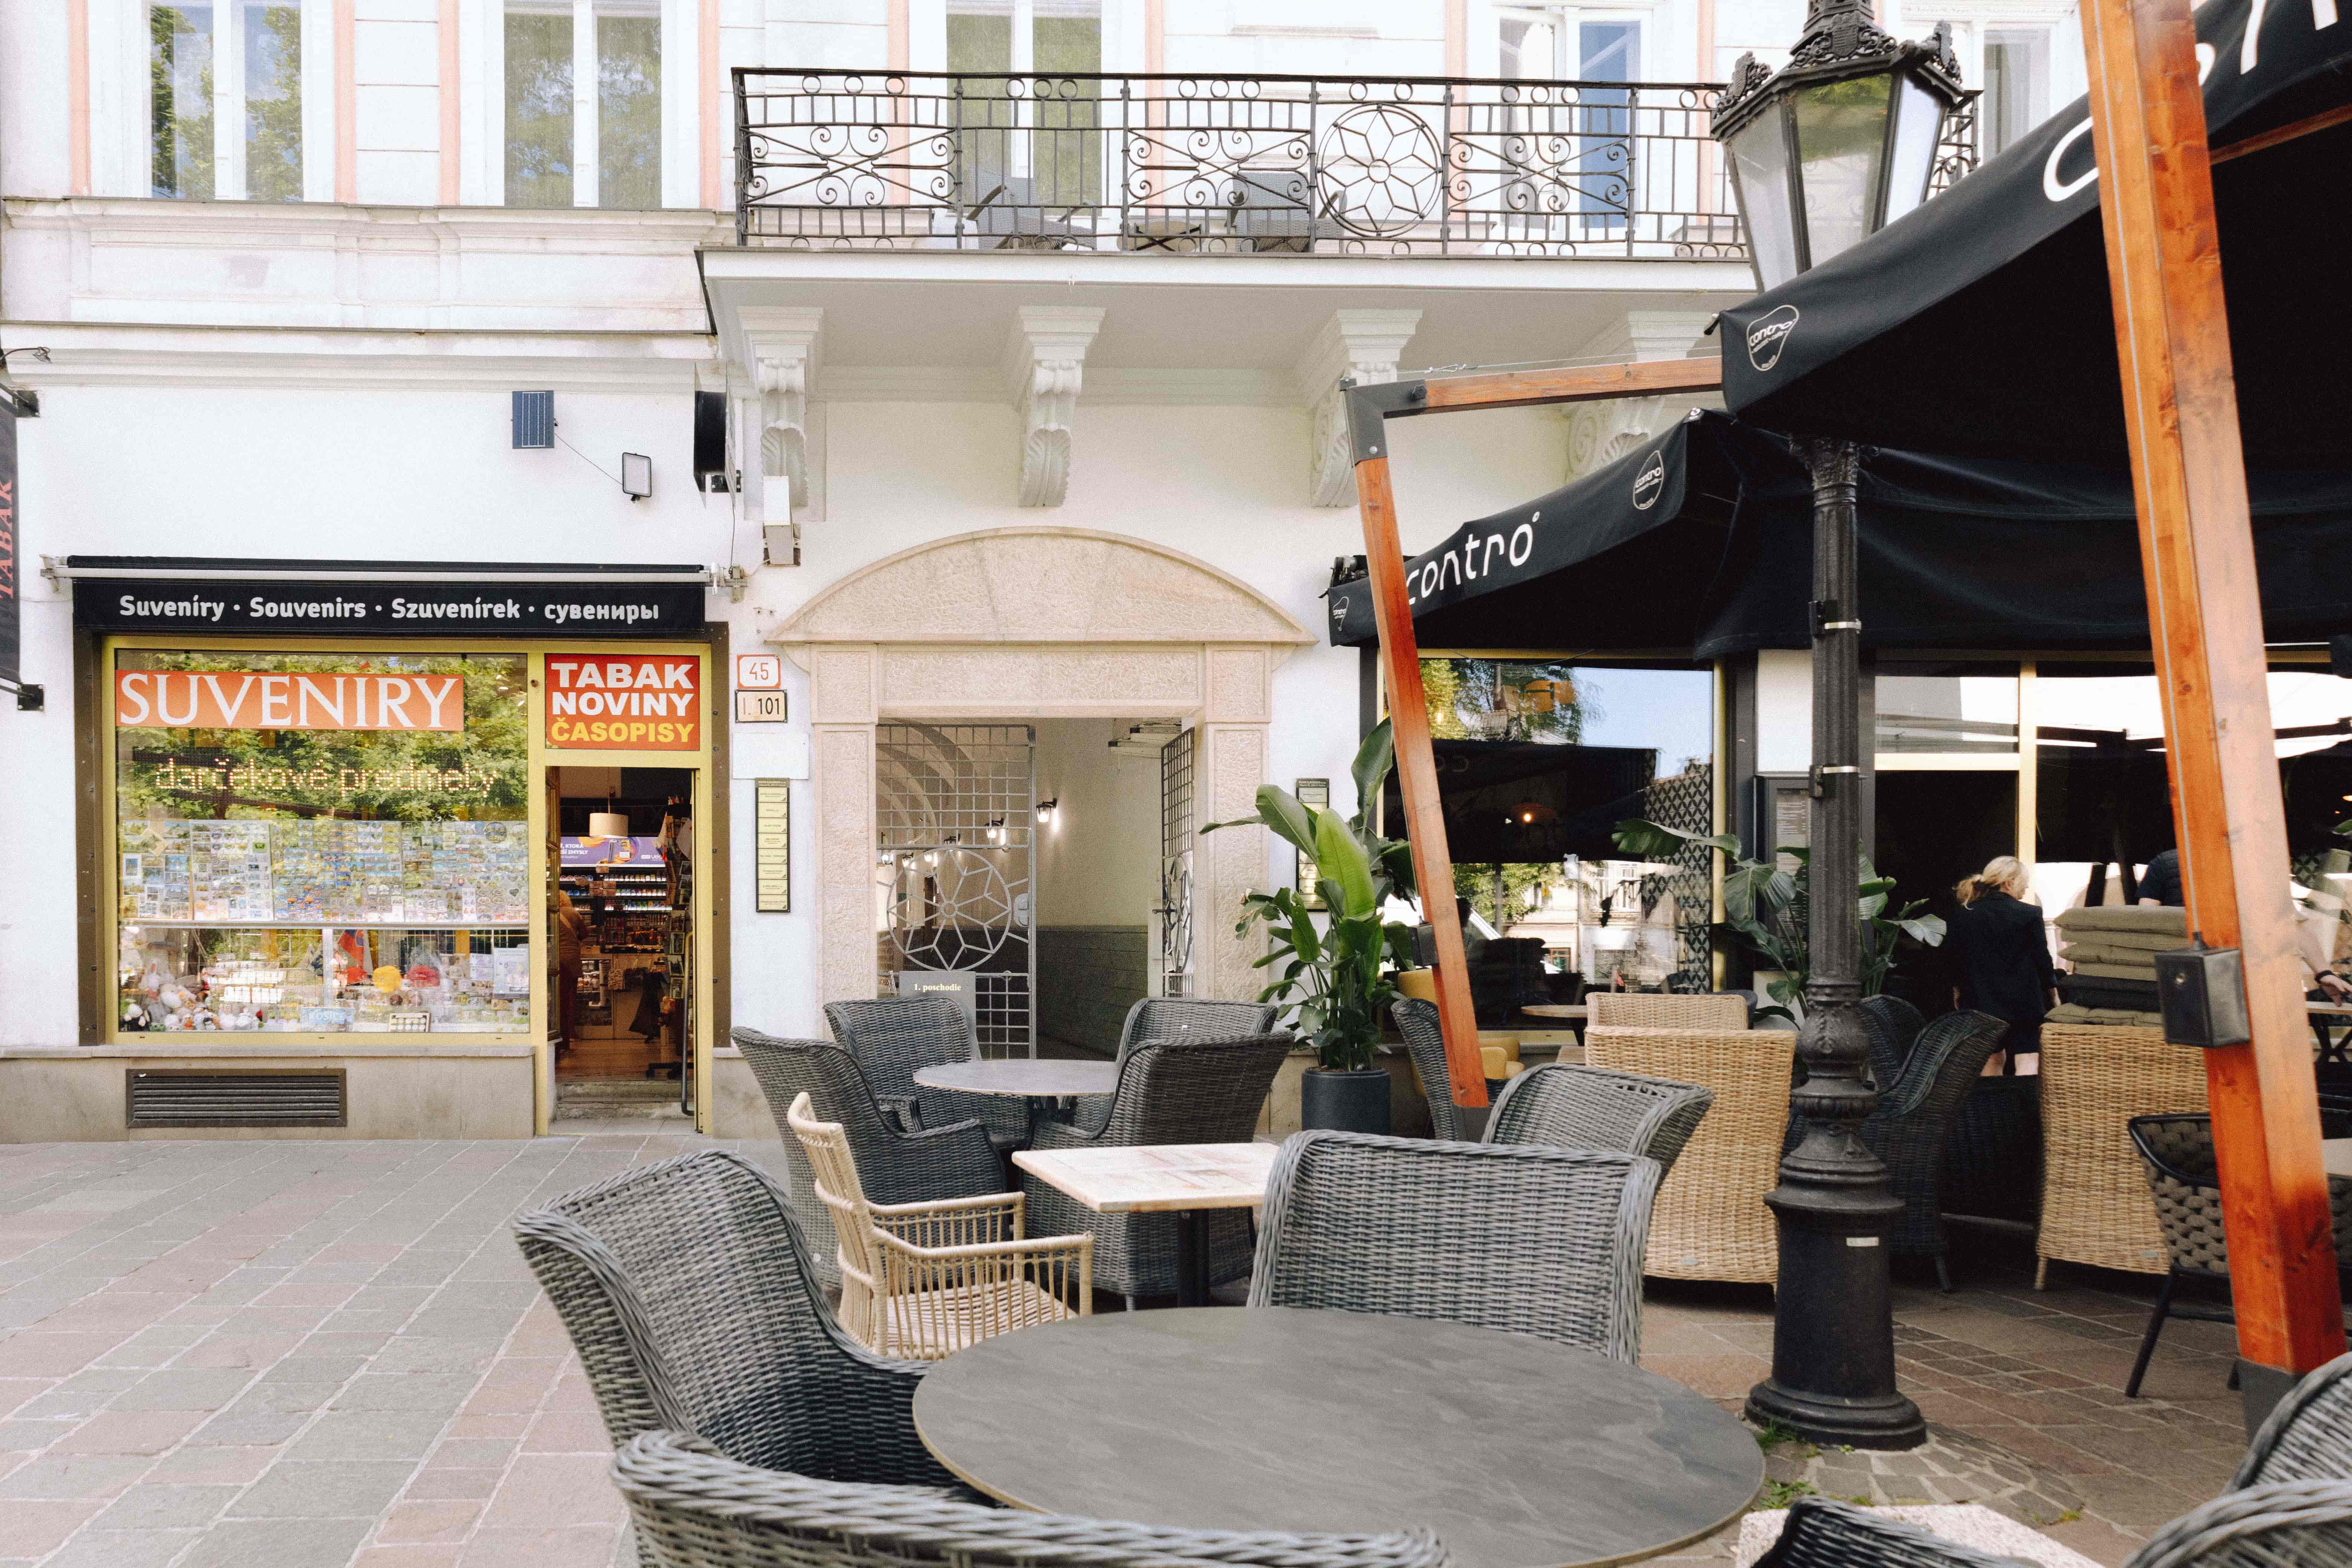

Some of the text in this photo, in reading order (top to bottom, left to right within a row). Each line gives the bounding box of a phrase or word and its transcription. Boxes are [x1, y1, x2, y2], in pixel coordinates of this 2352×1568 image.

[120, 595, 659, 624] Suveníry Souvenirs Szuvenírek сувениры
[551, 663, 694, 689] TABAK
[749, 662, 769, 680] 45
[552, 692, 694, 716] NOVINY
[758, 697, 780, 715] 101
[551, 717, 695, 743] ČASOPISY
[155, 757, 328, 790] darčekové
[923, 983, 962, 992] poschodie
